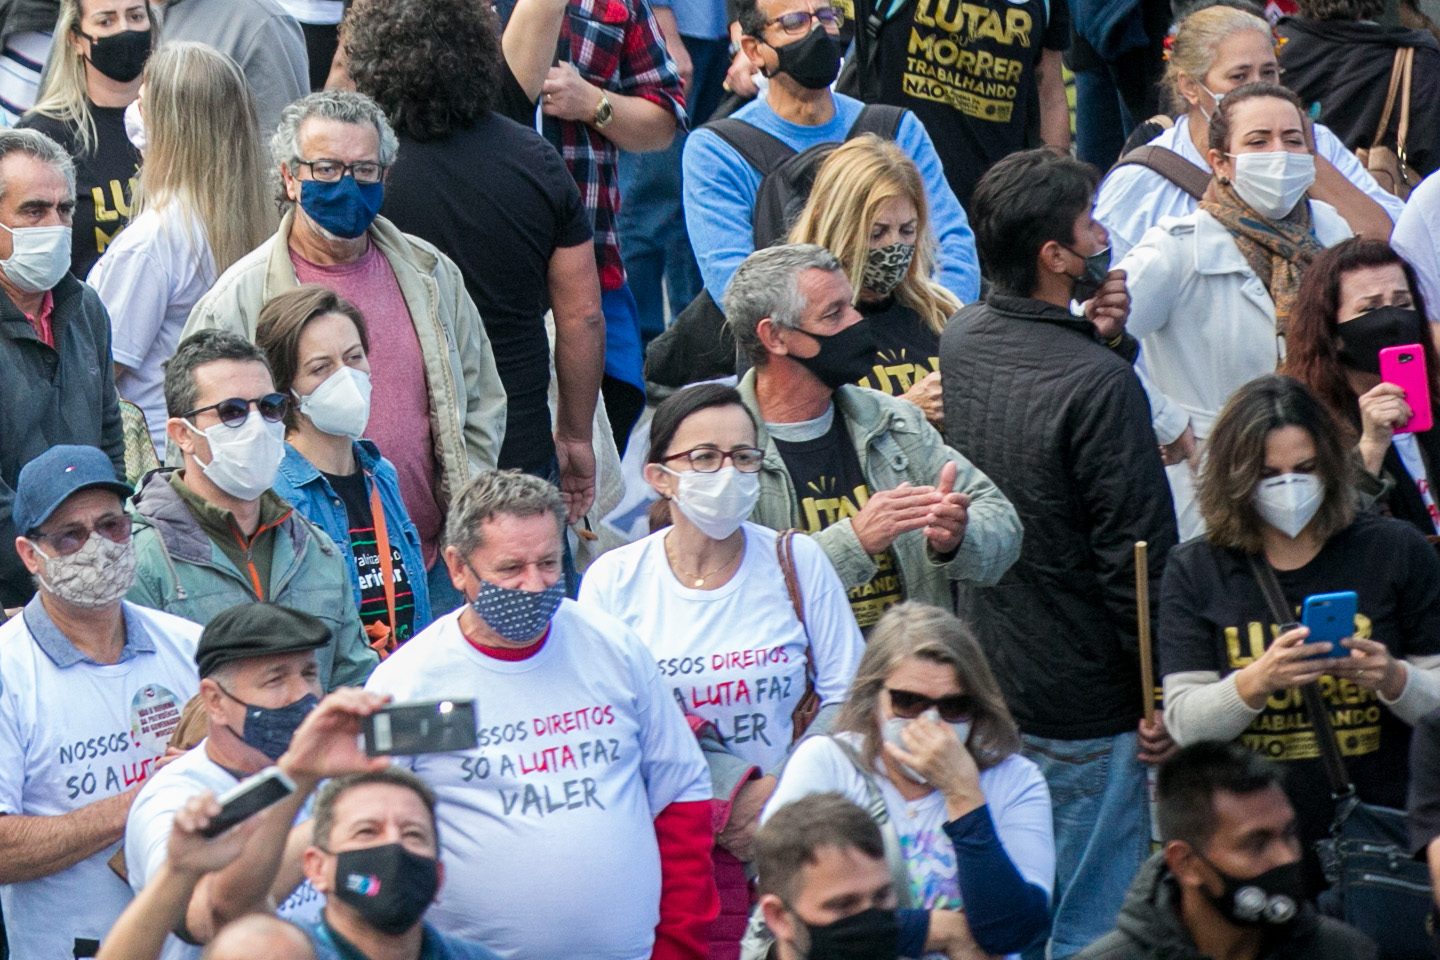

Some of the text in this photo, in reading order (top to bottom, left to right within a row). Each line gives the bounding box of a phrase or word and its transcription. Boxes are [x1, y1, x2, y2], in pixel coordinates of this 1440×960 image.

[907, 26, 1024, 84] MORRER
[905, 77, 945, 99] NÃO
[906, 56, 1017, 100] TRABALHANDO
[657, 645, 789, 677] SSOS DIREITOS
[691, 679, 752, 708] LUTA
[755, 676, 792, 704] FAZ
[476, 704, 615, 747] SSOS DIREITOS
[714, 712, 772, 747] LER
[59, 731, 130, 764] NOSSOS
[460, 738, 621, 782] SÓ A LUTA FAZ
[66, 755, 162, 800] SÓ A LUT
[497, 777, 606, 818] VALER
